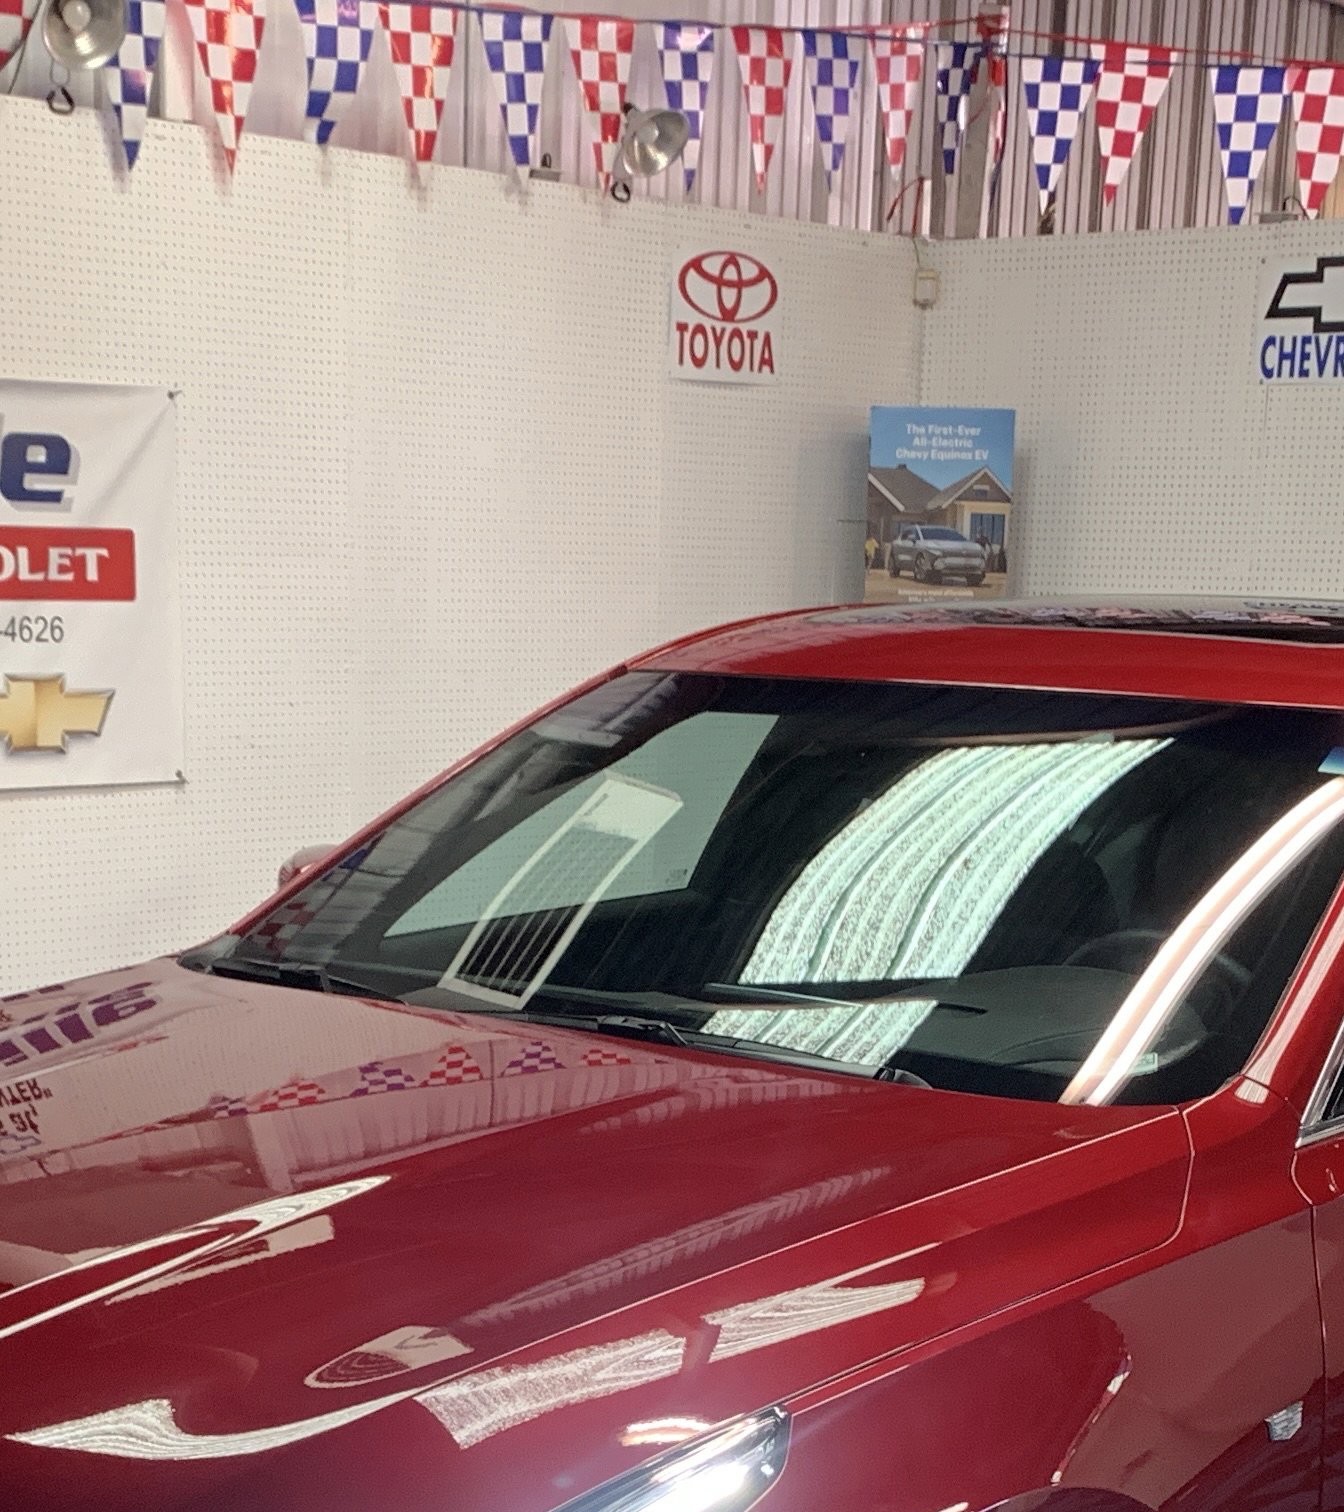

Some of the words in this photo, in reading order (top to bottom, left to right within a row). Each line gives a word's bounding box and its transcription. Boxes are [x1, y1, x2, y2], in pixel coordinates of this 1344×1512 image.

[676, 320, 775, 375] TOYOTA
[905, 423, 926, 435] The
[912, 436, 974, 448] All-Electric
[895, 449, 929, 461] Chevy
[930, 449, 973, 461] Equinox
[975, 449, 990, 460] EV
